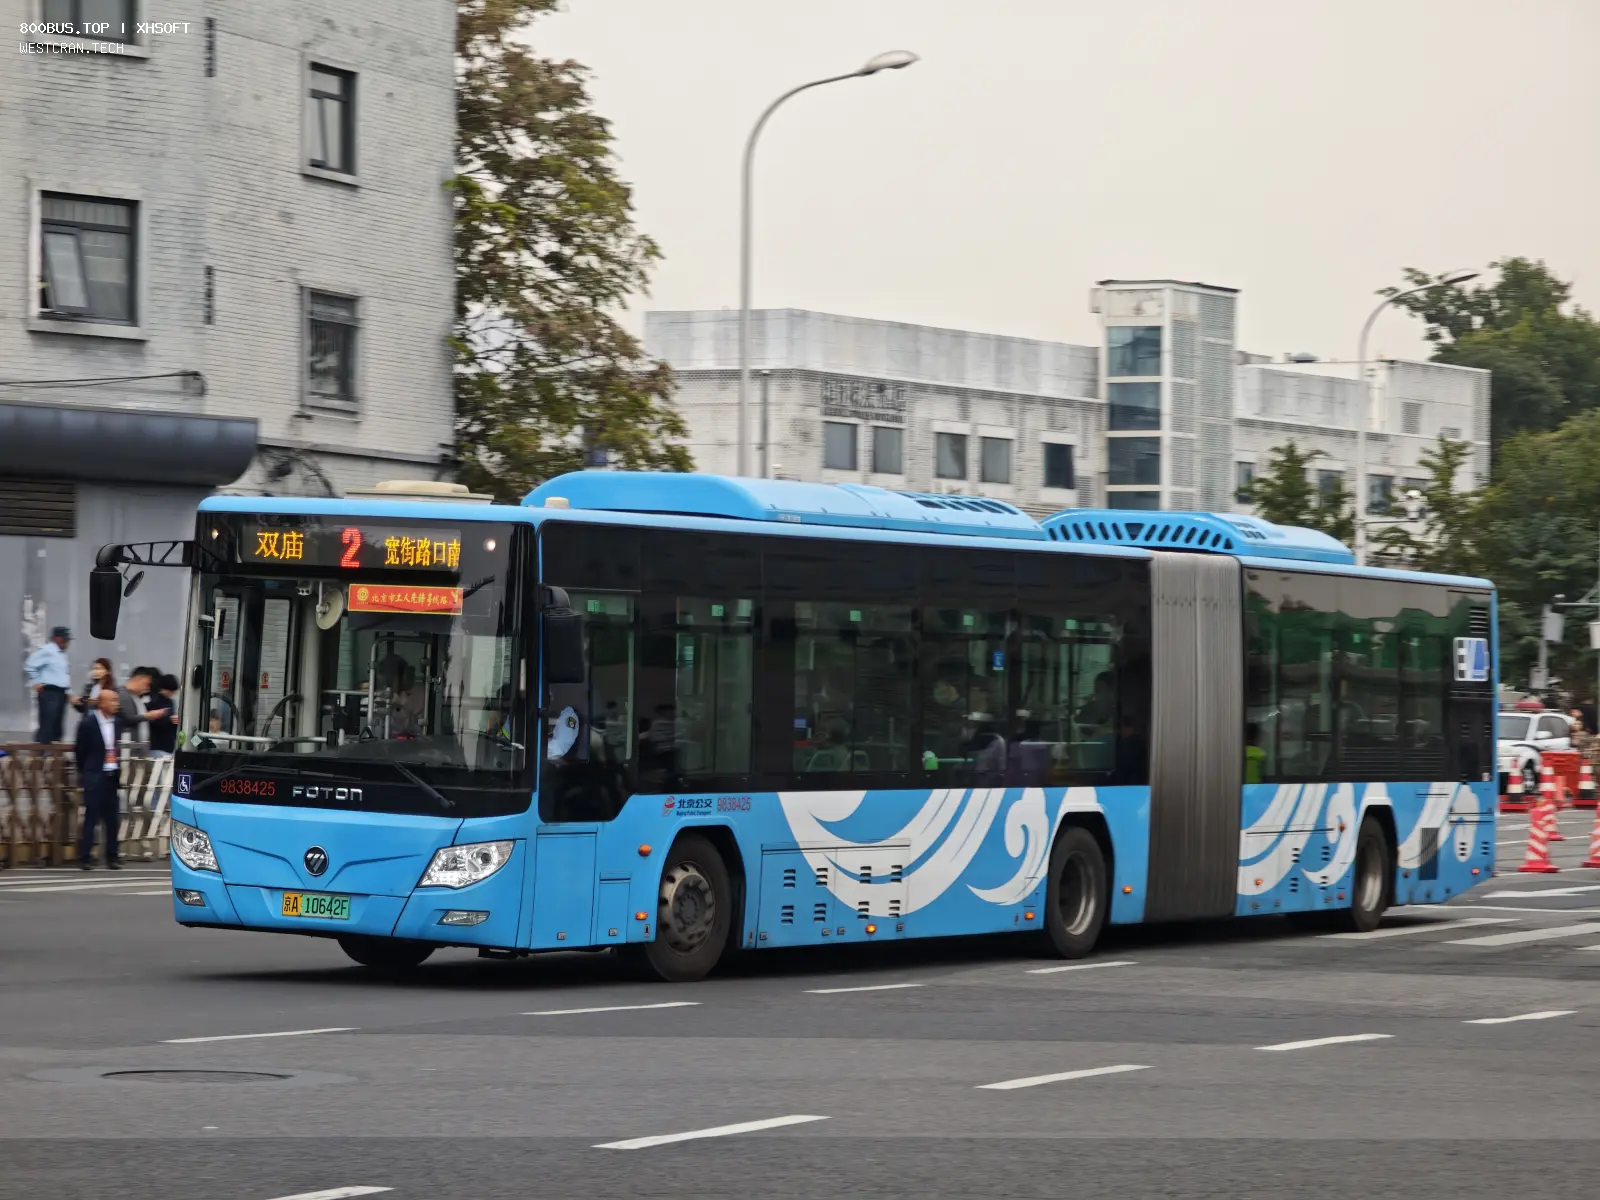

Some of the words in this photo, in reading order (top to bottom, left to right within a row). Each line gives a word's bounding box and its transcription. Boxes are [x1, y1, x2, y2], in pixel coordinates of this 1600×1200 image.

[255, 531, 304, 559] 双庙
[341, 528, 361, 568] 2
[384, 536, 461, 567] 宽街路口南
[220, 779, 276, 796] 9838425
[292, 786, 362, 802] FOTON
[677, 799, 712, 809] 北京公交
[717, 797, 751, 811] 9838425
